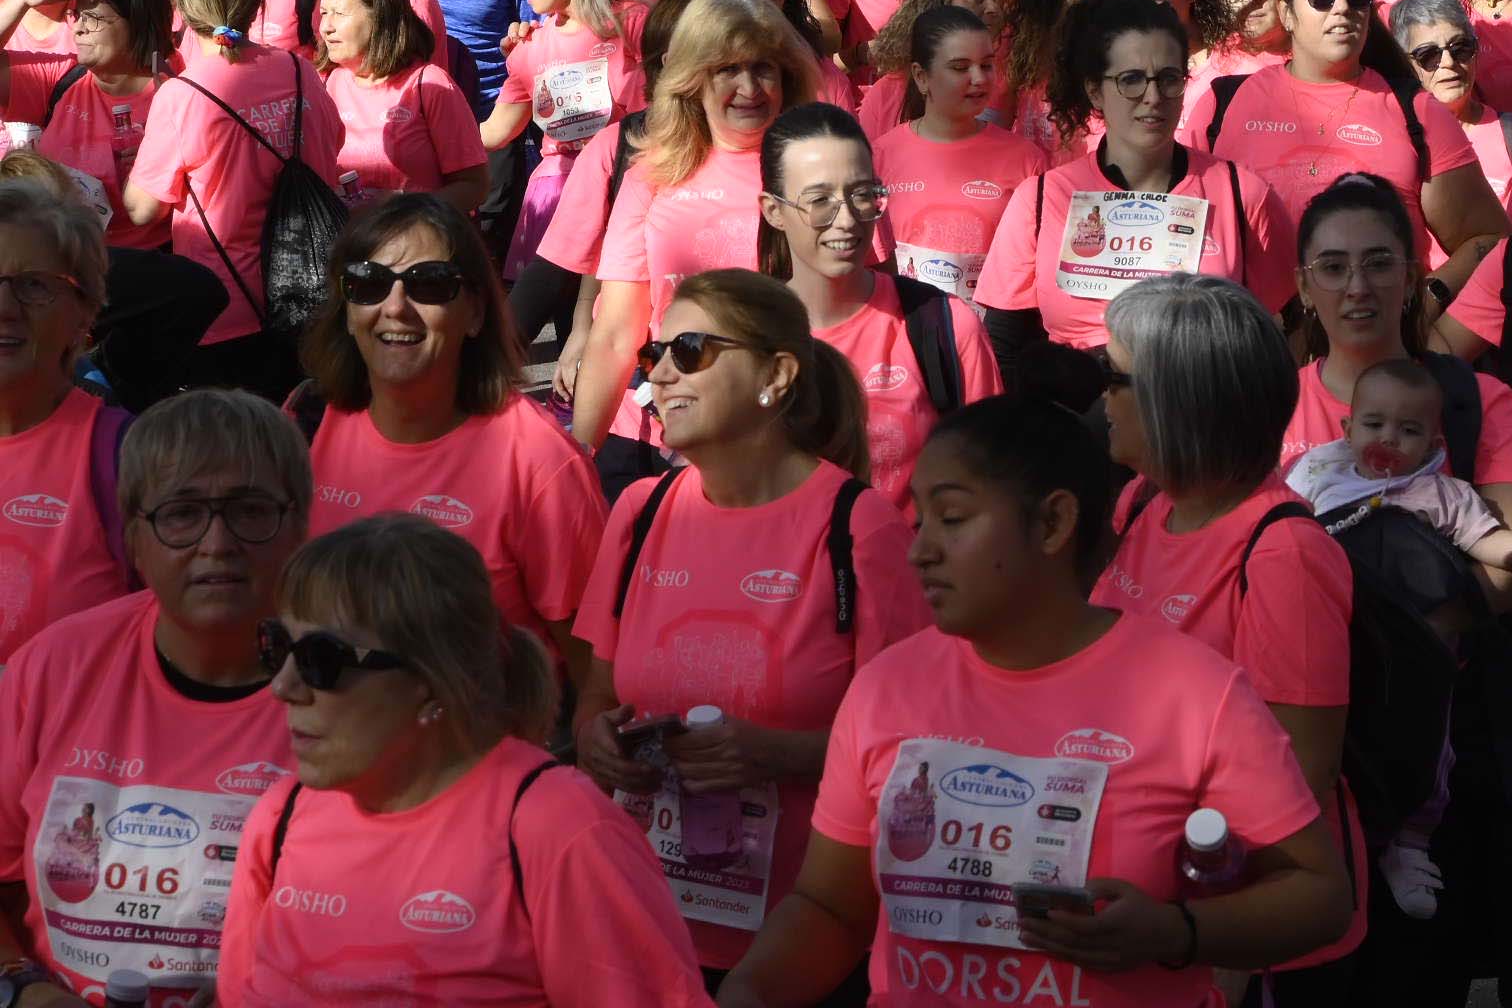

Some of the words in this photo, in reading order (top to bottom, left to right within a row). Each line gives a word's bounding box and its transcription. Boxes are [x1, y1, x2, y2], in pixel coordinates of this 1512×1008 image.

[1245, 121, 1296, 132] OYSHO
[1339, 130, 1380, 143] ASTURIANA
[1112, 211, 1160, 222] ASTURIANA
[1109, 235, 1153, 252] 016
[1114, 256, 1142, 266] 9087
[923, 265, 960, 280] ASTURIANA
[1073, 266, 1110, 276] CARRERA
[1066, 279, 1108, 291] OYSHO
[416, 505, 471, 524] ASTURIANA
[746, 578, 801, 595] ASTURIANA
[1061, 742, 1129, 759] ASTURIANA
[947, 775, 1027, 801] ASTURIANA
[1045, 782, 1086, 794] SUMA
[112, 821, 193, 840] ASTURIANA
[941, 819, 1012, 852] 016
[948, 857, 992, 877] 4788
[104, 863, 180, 895] 016
[687, 869, 723, 884] MUJER
[894, 879, 944, 894] CARRERA
[947, 884, 962, 895] DE
[965, 886, 980, 897] LA
[115, 901, 161, 920] 4787
[695, 894, 752, 914] Santander
[404, 906, 470, 924] ASTURIANA
[893, 906, 943, 926] OYSHO
[60, 918, 111, 936] CARRERA
[113, 926, 131, 938] DE
[135, 928, 150, 940] LA
[154, 931, 198, 944] MUJER
[897, 945, 1090, 1006] DORSAL
